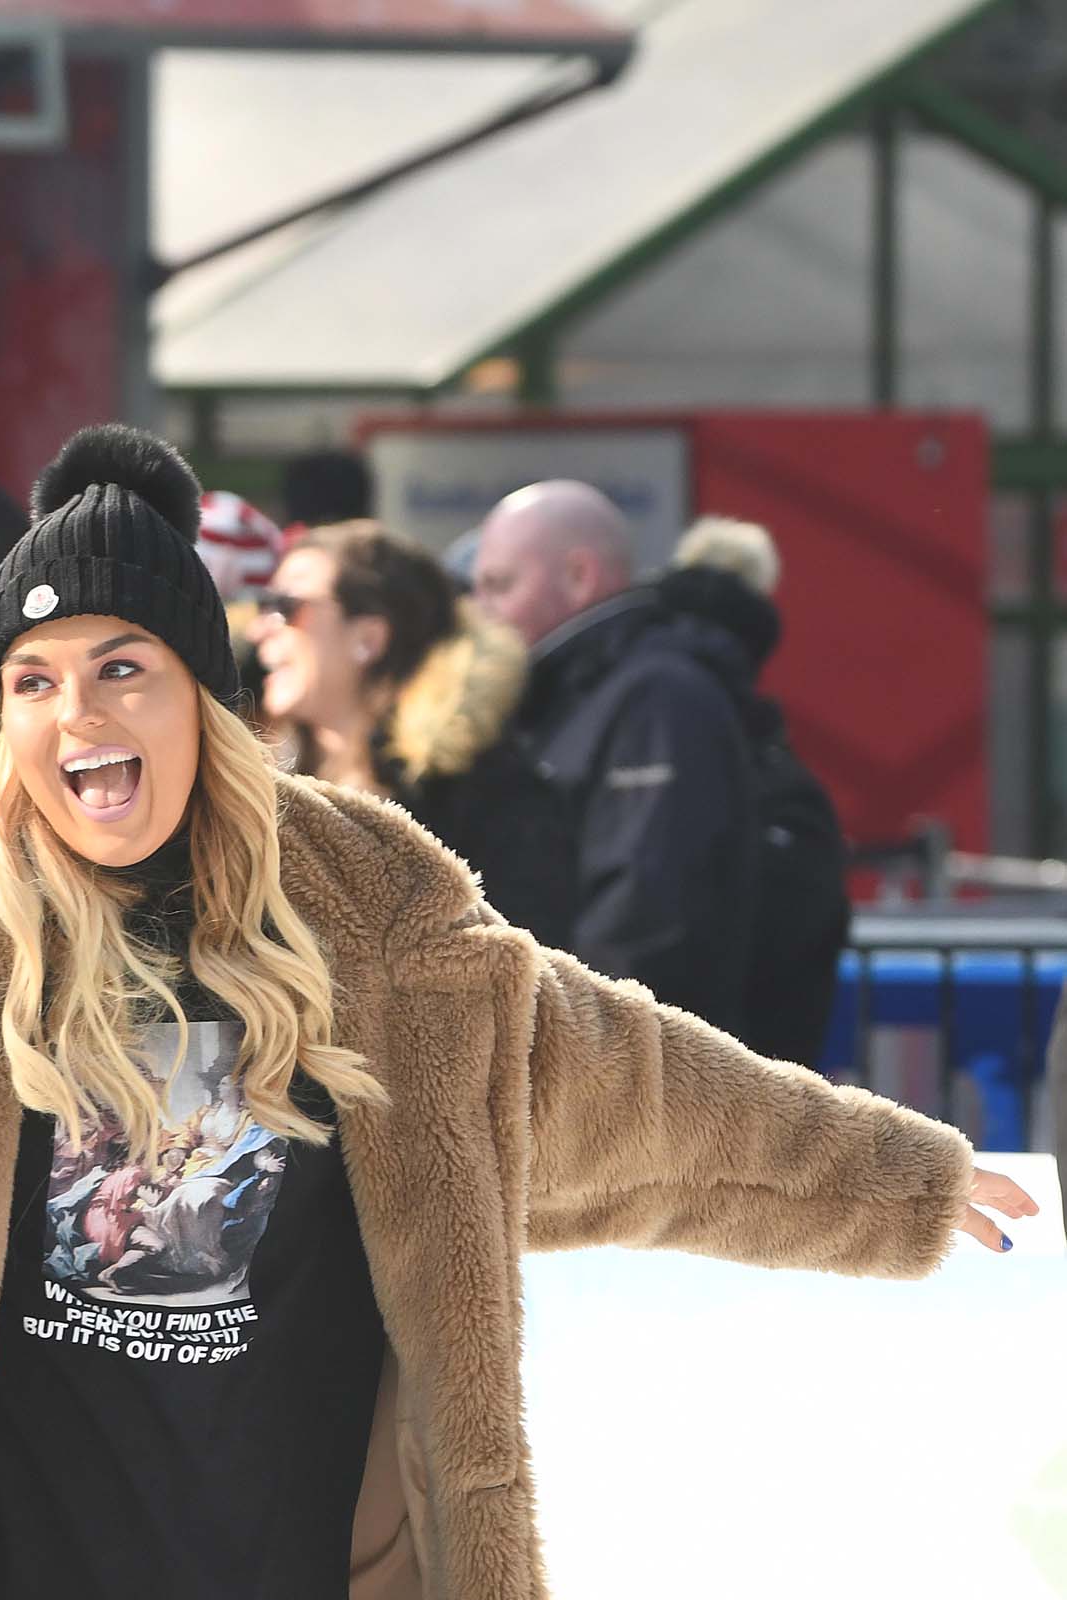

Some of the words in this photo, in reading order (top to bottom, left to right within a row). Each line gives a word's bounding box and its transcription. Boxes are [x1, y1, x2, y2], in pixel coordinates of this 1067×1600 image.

[44, 1280, 108, 1316] WN
[114, 1308, 162, 1331] YOU
[165, 1312, 212, 1332] FIND
[214, 1304, 259, 1327] THE
[23, 1316, 69, 1341] BUT
[71, 1326, 94, 1345] IT
[98, 1334, 122, 1352] IS
[126, 1340, 175, 1362] OUT
[177, 1344, 209, 1364] OF
